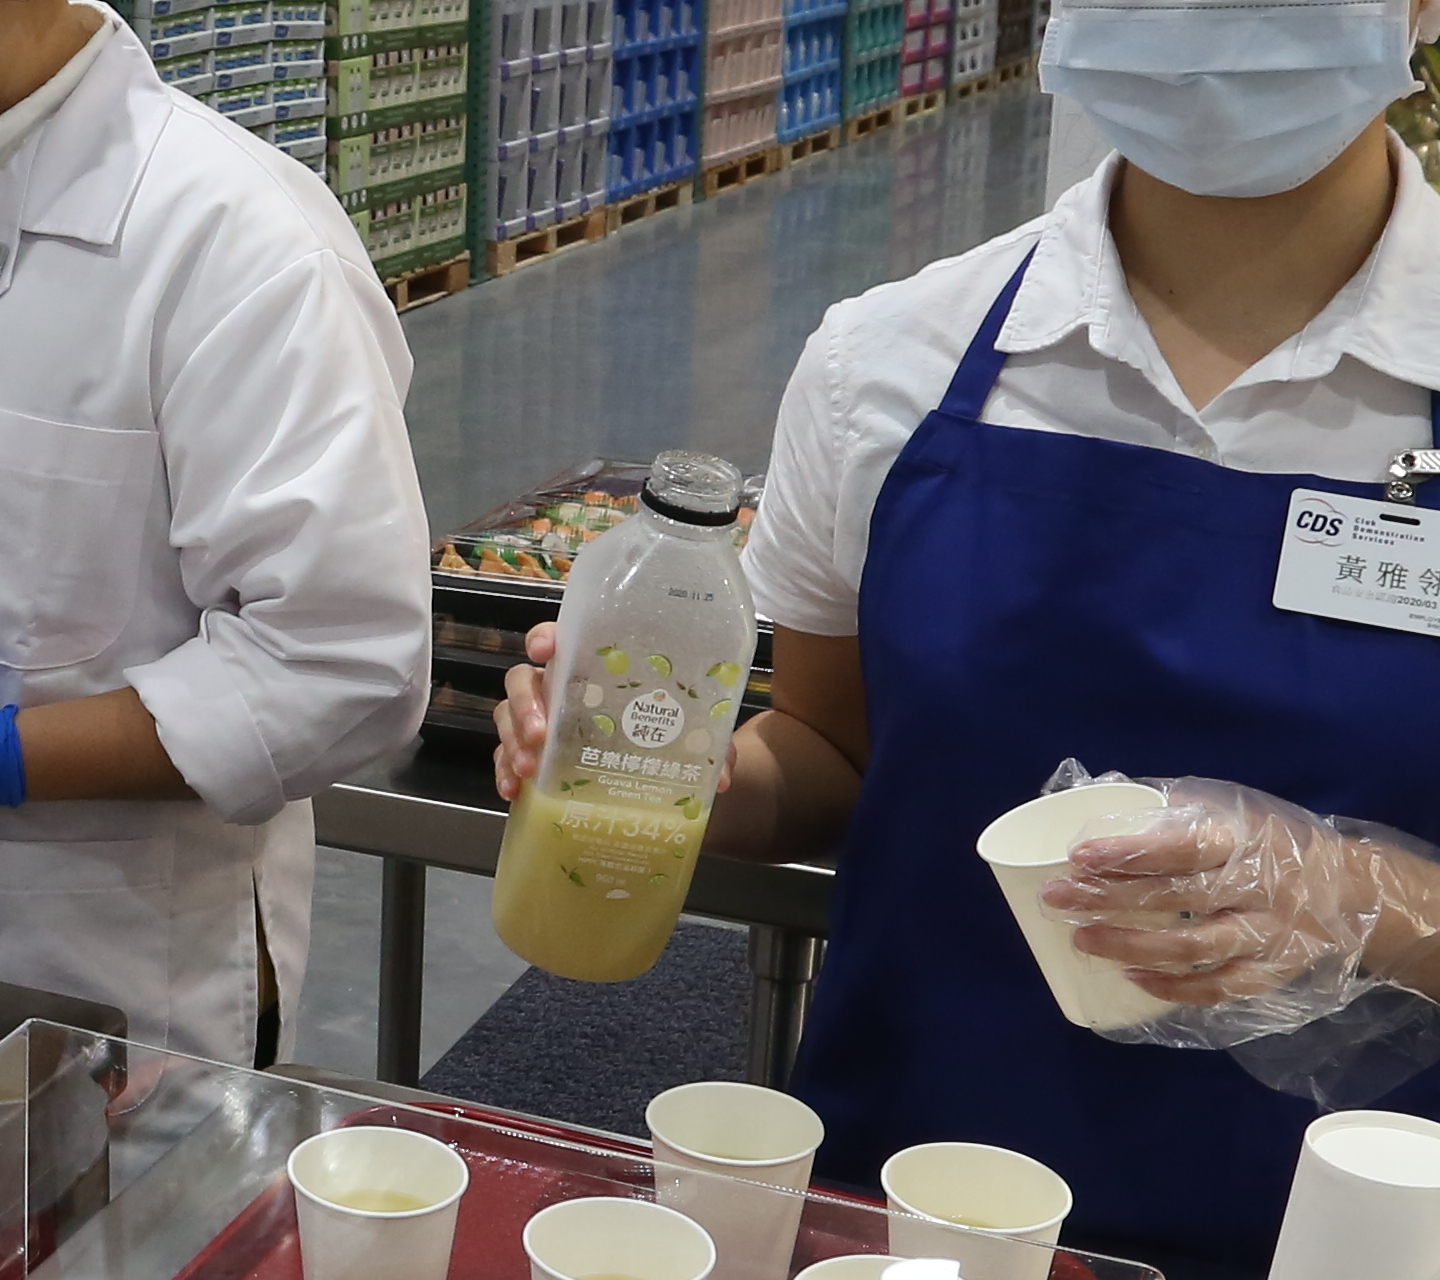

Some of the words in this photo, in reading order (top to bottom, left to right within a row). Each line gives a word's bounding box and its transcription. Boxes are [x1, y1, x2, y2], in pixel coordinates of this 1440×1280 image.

[1295, 509, 1344, 538] CDS
[630, 711, 676, 728] Benefits
[631, 699, 681, 720] Natural
[631, 723, 668, 744] 純在
[579, 744, 703, 783] 芭樂檸檬綠茶
[597, 774, 634, 791] Guava
[635, 780, 673, 796] Lemon
[607, 785, 641, 801] Green
